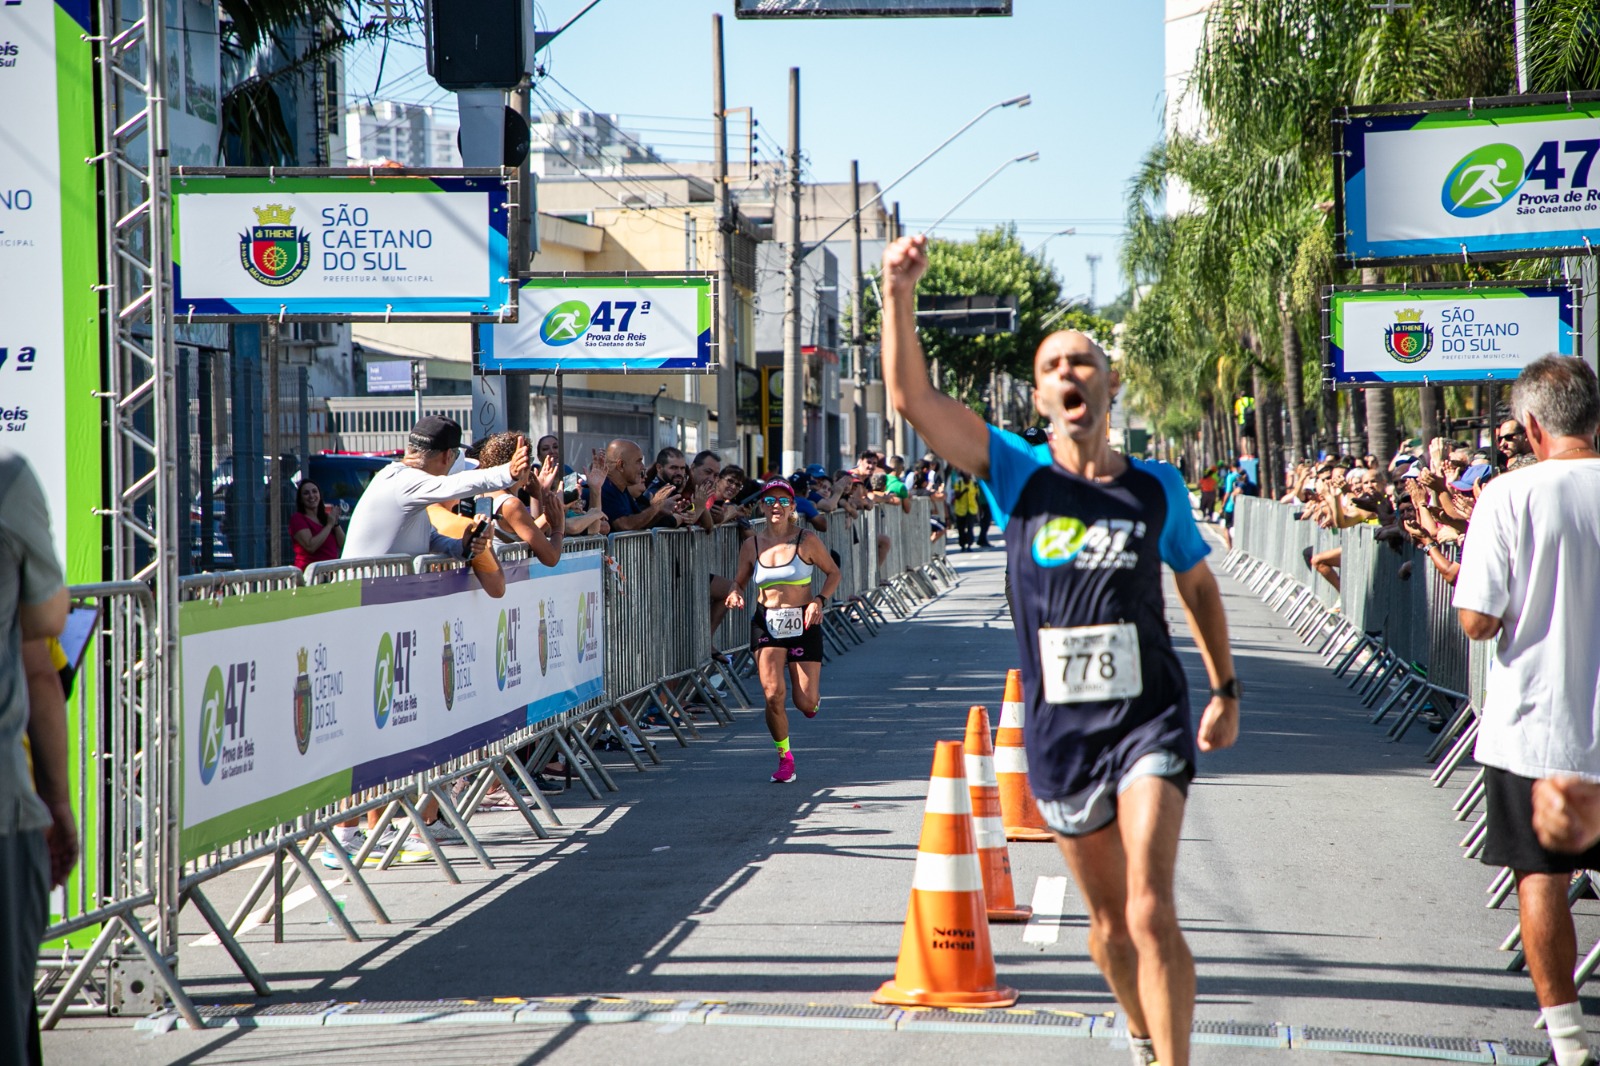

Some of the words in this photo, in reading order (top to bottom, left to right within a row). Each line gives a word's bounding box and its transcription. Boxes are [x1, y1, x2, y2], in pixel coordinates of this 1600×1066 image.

[1518, 193, 1559, 205] Prova
[1563, 190, 1583, 203] de
[321, 203, 369, 227] SÃO
[1516, 205, 1536, 215] São
[1538, 204, 1582, 214] Caetano
[1584, 202, 1598, 211] do
[264, 229, 295, 238] THIENE
[322, 229, 432, 249] CAETANO
[323, 252, 356, 271] DO
[363, 252, 407, 271] SUL
[259, 275, 285, 285] CAETANO
[591, 300, 651, 332] 47ª
[1441, 306, 1475, 323] SÃO
[586, 333, 611, 341] Prova
[613, 333, 625, 341] de
[627, 332, 647, 341] Reis
[1442, 322, 1519, 338] CAETANO
[1442, 338, 1465, 352] DO
[1470, 338, 1501, 352] SUL
[7, 423, 26, 431] Sul
[454, 617, 463, 642] SÃO
[507, 607, 520, 662] 47ª
[768, 618, 801, 631] 1740
[314, 643, 327, 673] SÃO
[394, 630, 417, 694] 47ª
[455, 642, 476, 666] CAETANO
[1058, 652, 1116, 683] 778
[315, 671, 343, 701] CAETANO
[456, 668, 463, 690] DO
[463, 667, 472, 688] SUL
[225, 660, 256, 741] 47ª
[392, 698, 403, 714] Prova
[404, 695, 408, 711] de
[409, 694, 417, 709] Reis
[315, 703, 324, 729] DO
[325, 701, 337, 727] SUL
[222, 746, 235, 765] Prova
[237, 741, 243, 760] de
[244, 738, 254, 757] Reis
[228, 763, 243, 777] Caetano
[932, 927, 975, 938] Nova
[931, 940, 975, 951] Ideal
